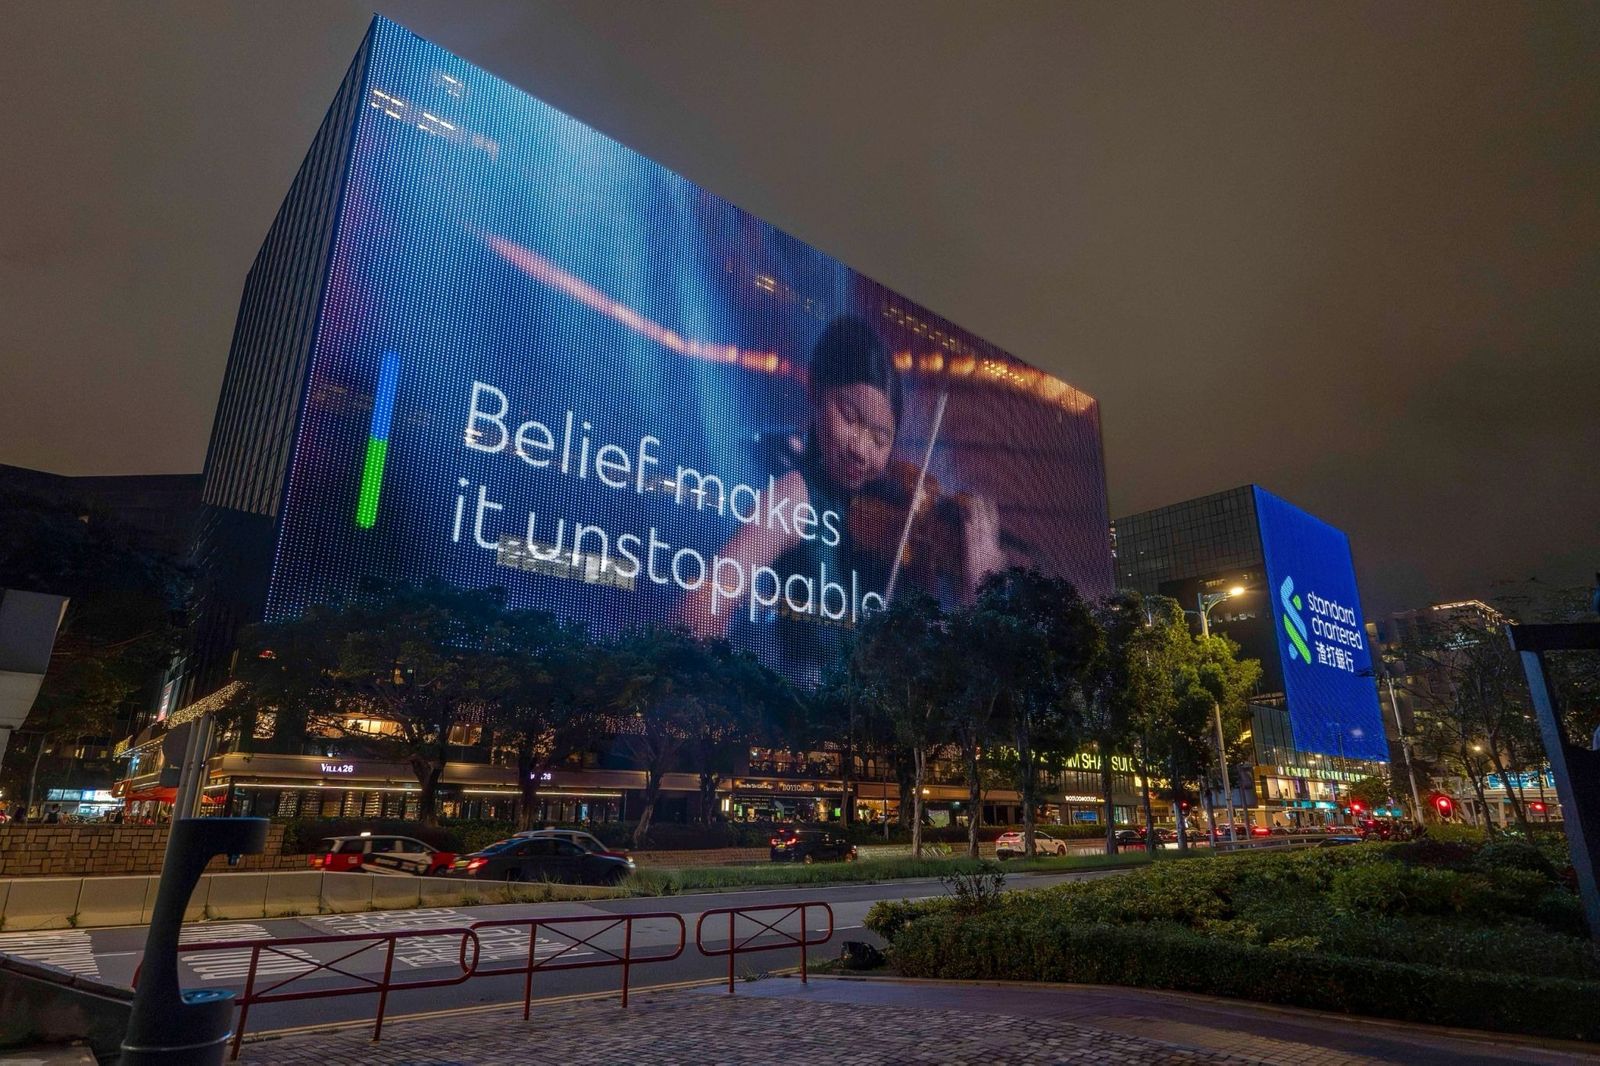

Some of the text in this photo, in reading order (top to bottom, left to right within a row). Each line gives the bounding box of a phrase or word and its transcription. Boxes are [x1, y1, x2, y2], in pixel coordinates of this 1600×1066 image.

[465, 381, 842, 547] Belief makes
[451, 477, 887, 624] it unstoppable
[1307, 591, 1356, 627] standard
[1311, 614, 1363, 650] chartered
[1315, 640, 1355, 673] 渣打銀行
